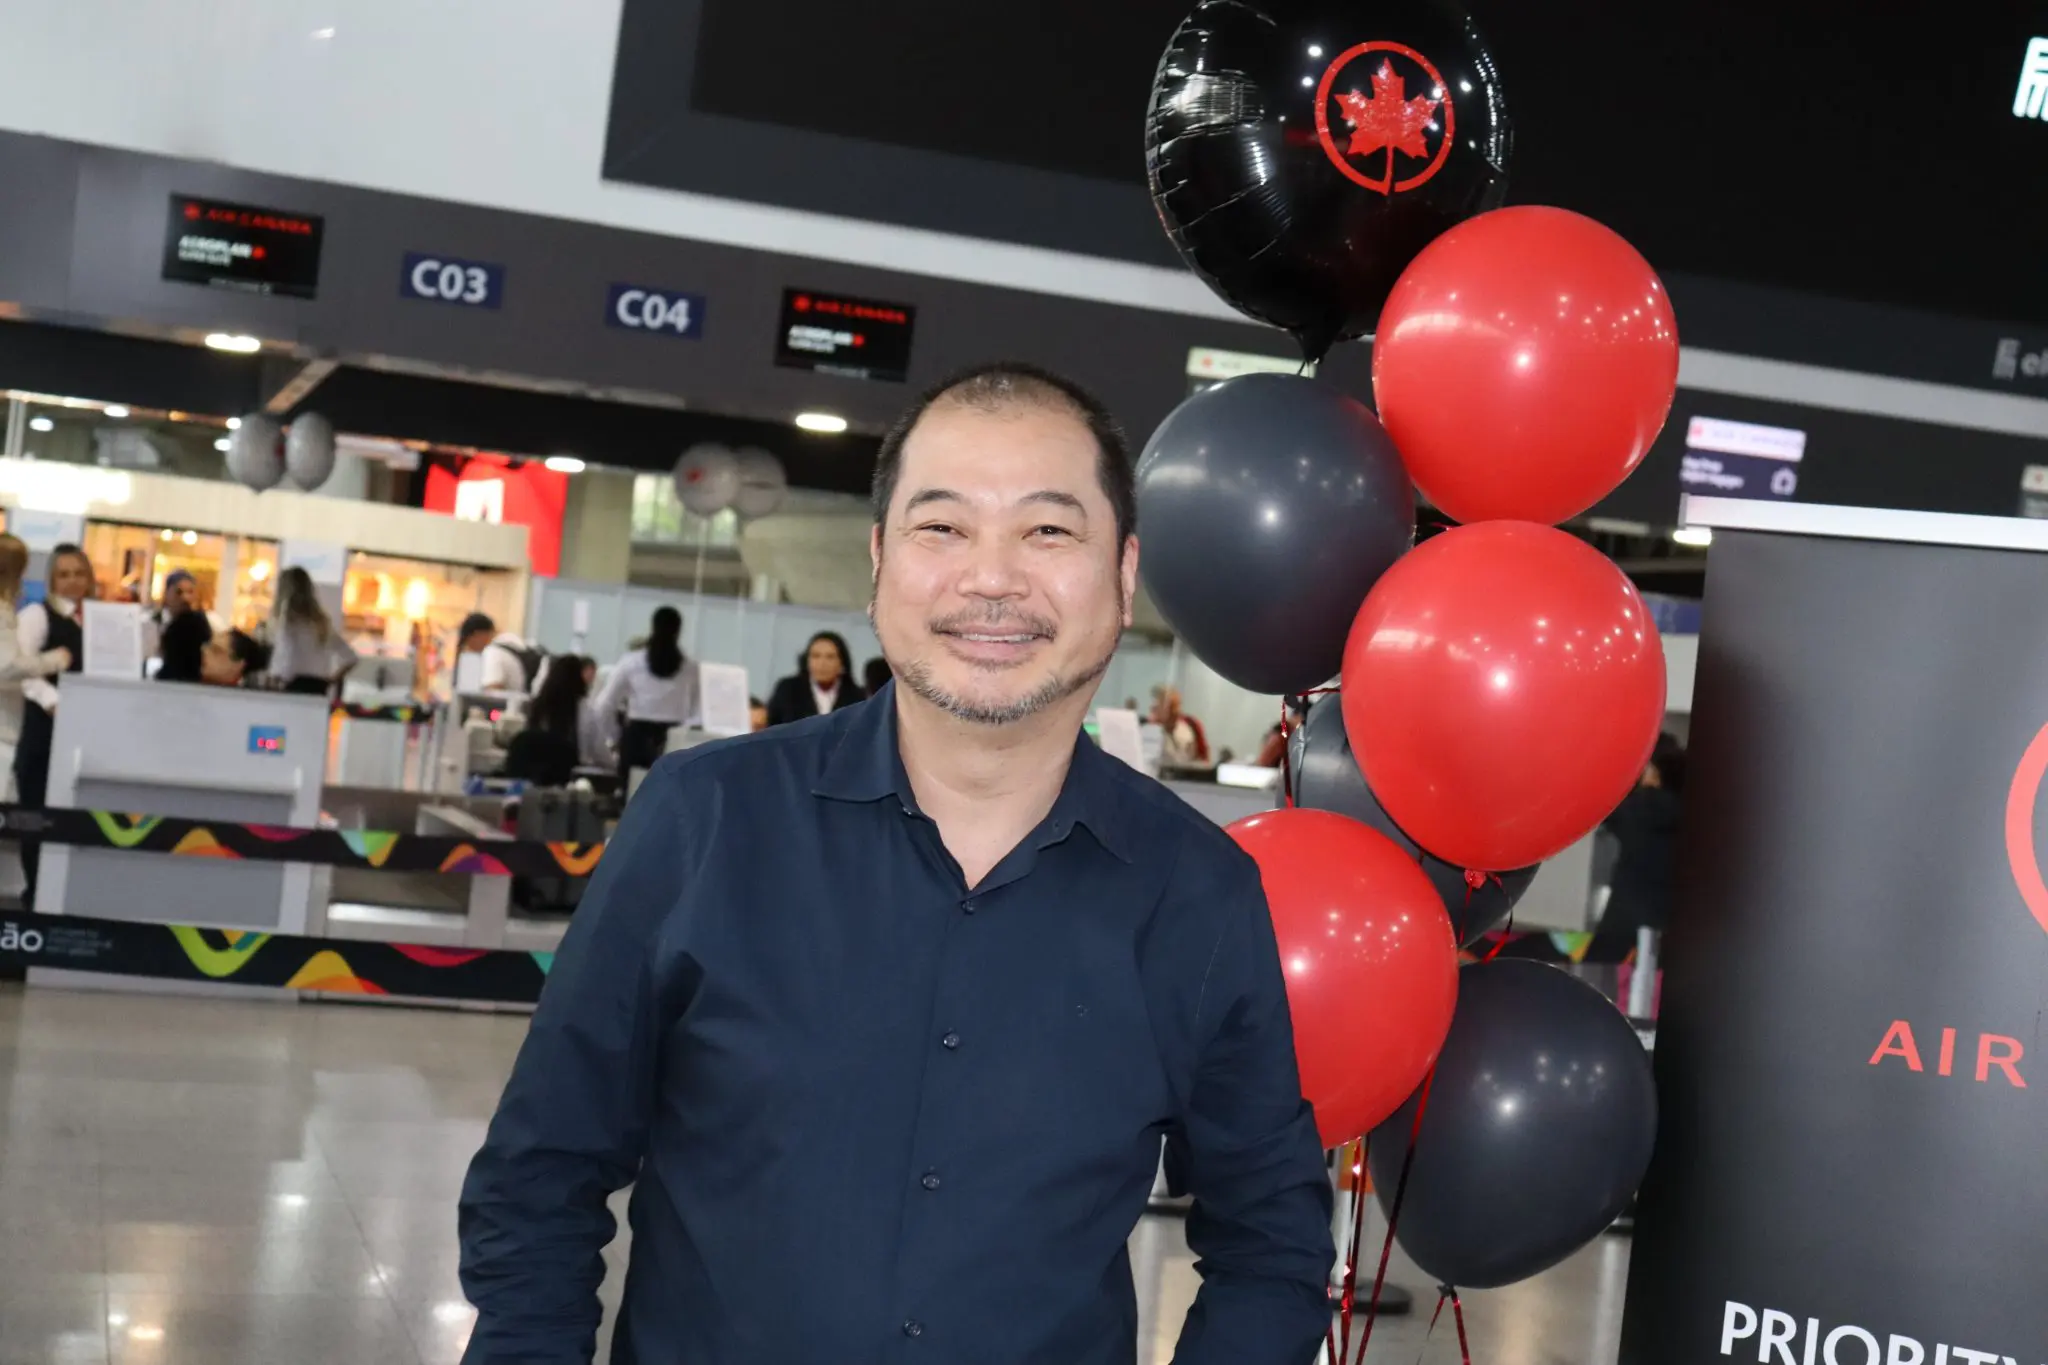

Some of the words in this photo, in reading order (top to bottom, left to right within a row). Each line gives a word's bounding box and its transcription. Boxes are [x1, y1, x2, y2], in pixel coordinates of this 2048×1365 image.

[411, 259, 489, 303] C03
[616, 289, 691, 333] C04
[1868, 1019, 2028, 1088] AIR
